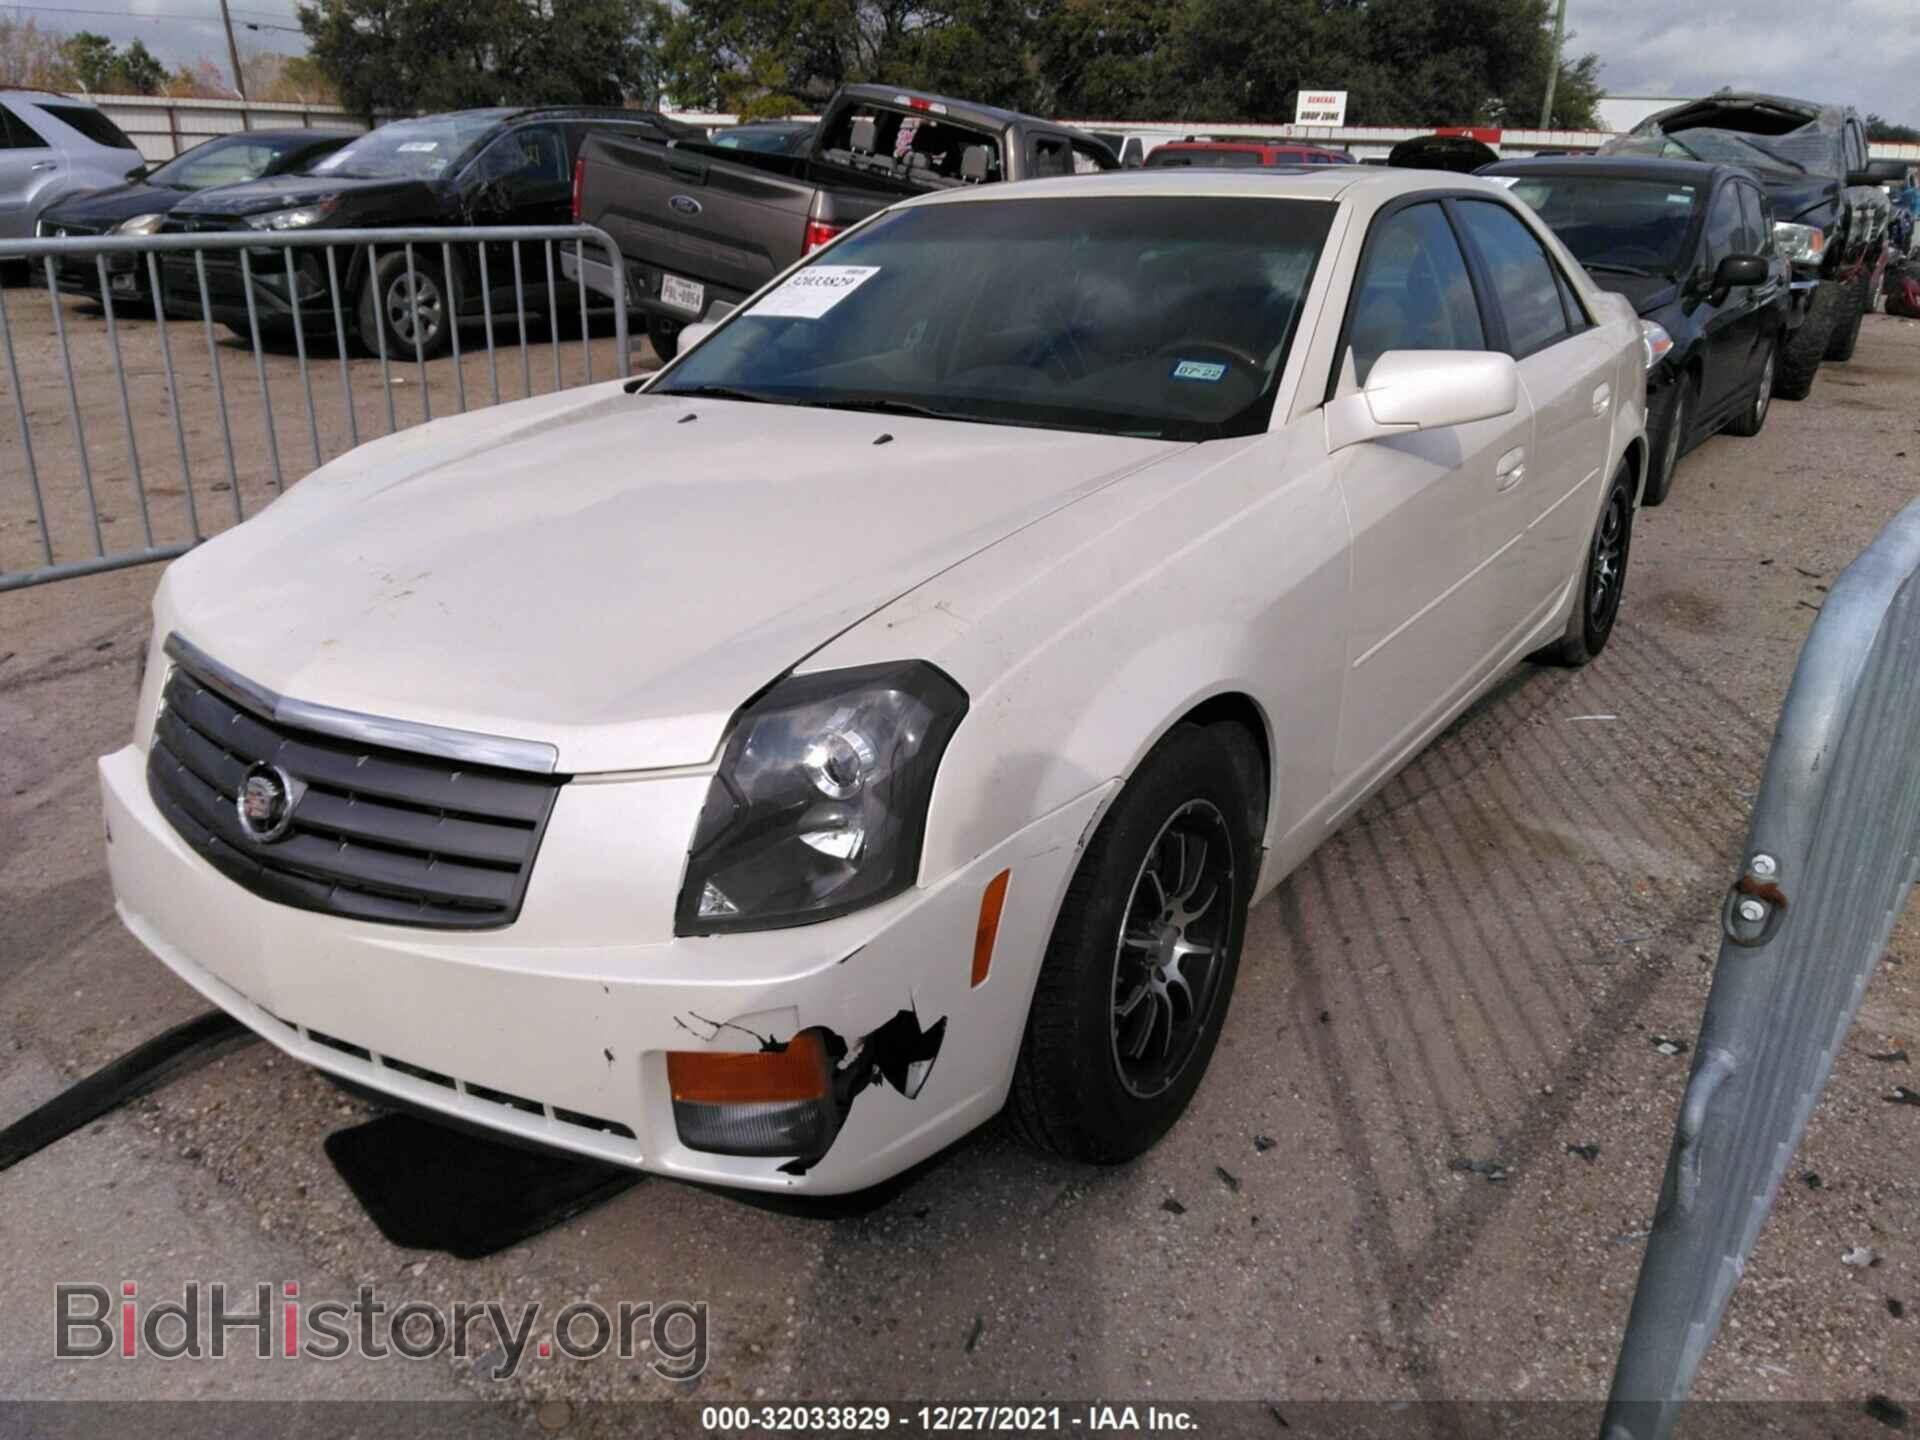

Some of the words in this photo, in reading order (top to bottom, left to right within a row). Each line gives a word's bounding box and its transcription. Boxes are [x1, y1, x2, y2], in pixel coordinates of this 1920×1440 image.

[1307, 95, 1337, 105] GENERAL
[1300, 111, 1321, 121] DROP
[1320, 111, 1340, 121] ZONE
